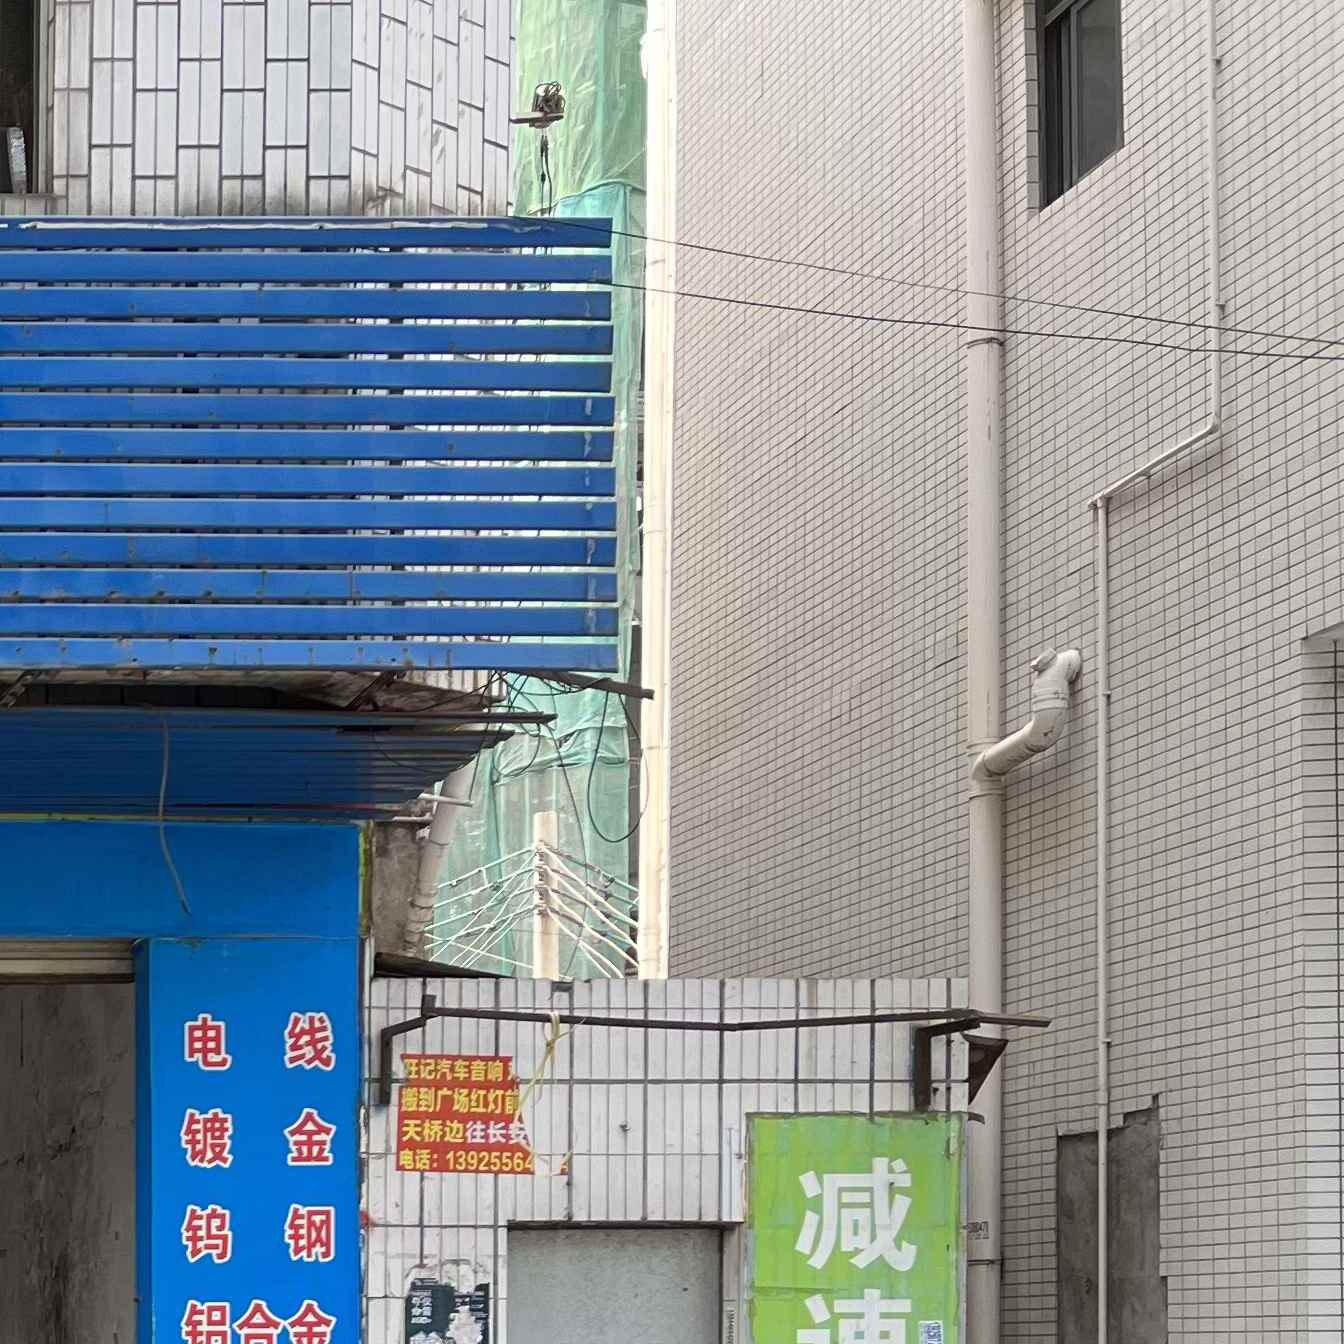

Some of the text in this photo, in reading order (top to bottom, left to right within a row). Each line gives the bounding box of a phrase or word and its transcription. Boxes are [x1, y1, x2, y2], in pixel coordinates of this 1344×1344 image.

[184, 1011, 335, 1071] 电线
[182, 1107, 337, 1168] 镀金
[182, 1203, 336, 1264] 钨钢
